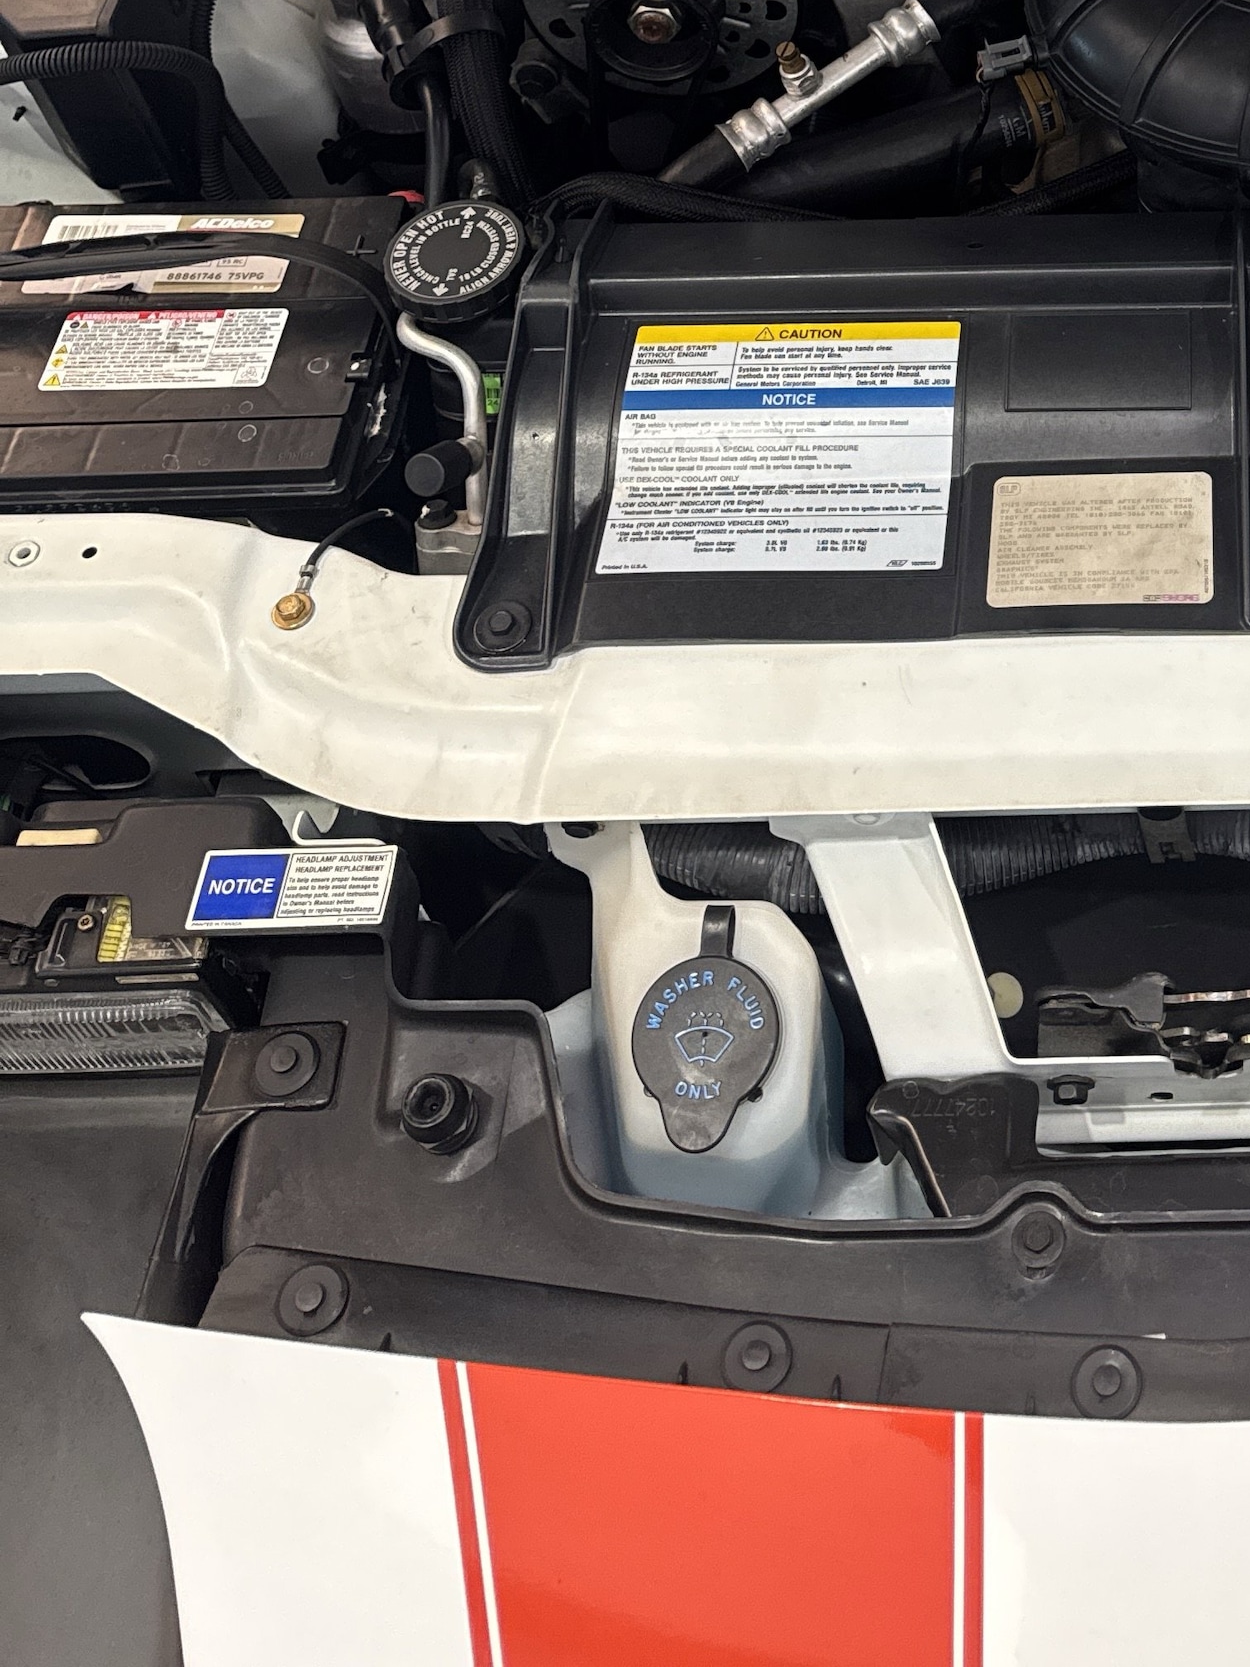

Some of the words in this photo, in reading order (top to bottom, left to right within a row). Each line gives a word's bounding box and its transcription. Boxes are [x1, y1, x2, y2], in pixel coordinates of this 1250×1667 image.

[190, 218, 274, 229] ACDelco
[416, 210, 444, 229] HOT
[484, 209, 508, 225] TUBE
[425, 218, 460, 236] BOTTLE
[476, 220, 499, 243] SYSTEM
[501, 223, 516, 243] VENT
[394, 229, 420, 258] OPEN
[416, 236, 427, 245] IN
[409, 245, 420, 268] LEVEL
[482, 243, 500, 269] CLOSED
[488, 250, 514, 279] ARROW
[228, 272, 264, 280] 75VPG
[393, 260, 421, 291] NEVER
[412, 266, 440, 284] CHECK
[471, 267, 482, 277] LB
[459, 275, 489, 295] ALIGN
[779, 329, 843, 339] CAUTION
[762, 393, 817, 406] NOTICE
[296, 855, 337, 863] HEADLAMP
[338, 854, 388, 862] ADJUSTMENT
[208, 878, 276, 895] NOTICE
[646, 970, 715, 1030] WASHER
[726, 977, 765, 1030] FLUID
[675, 1081, 722, 1100] ONLY
